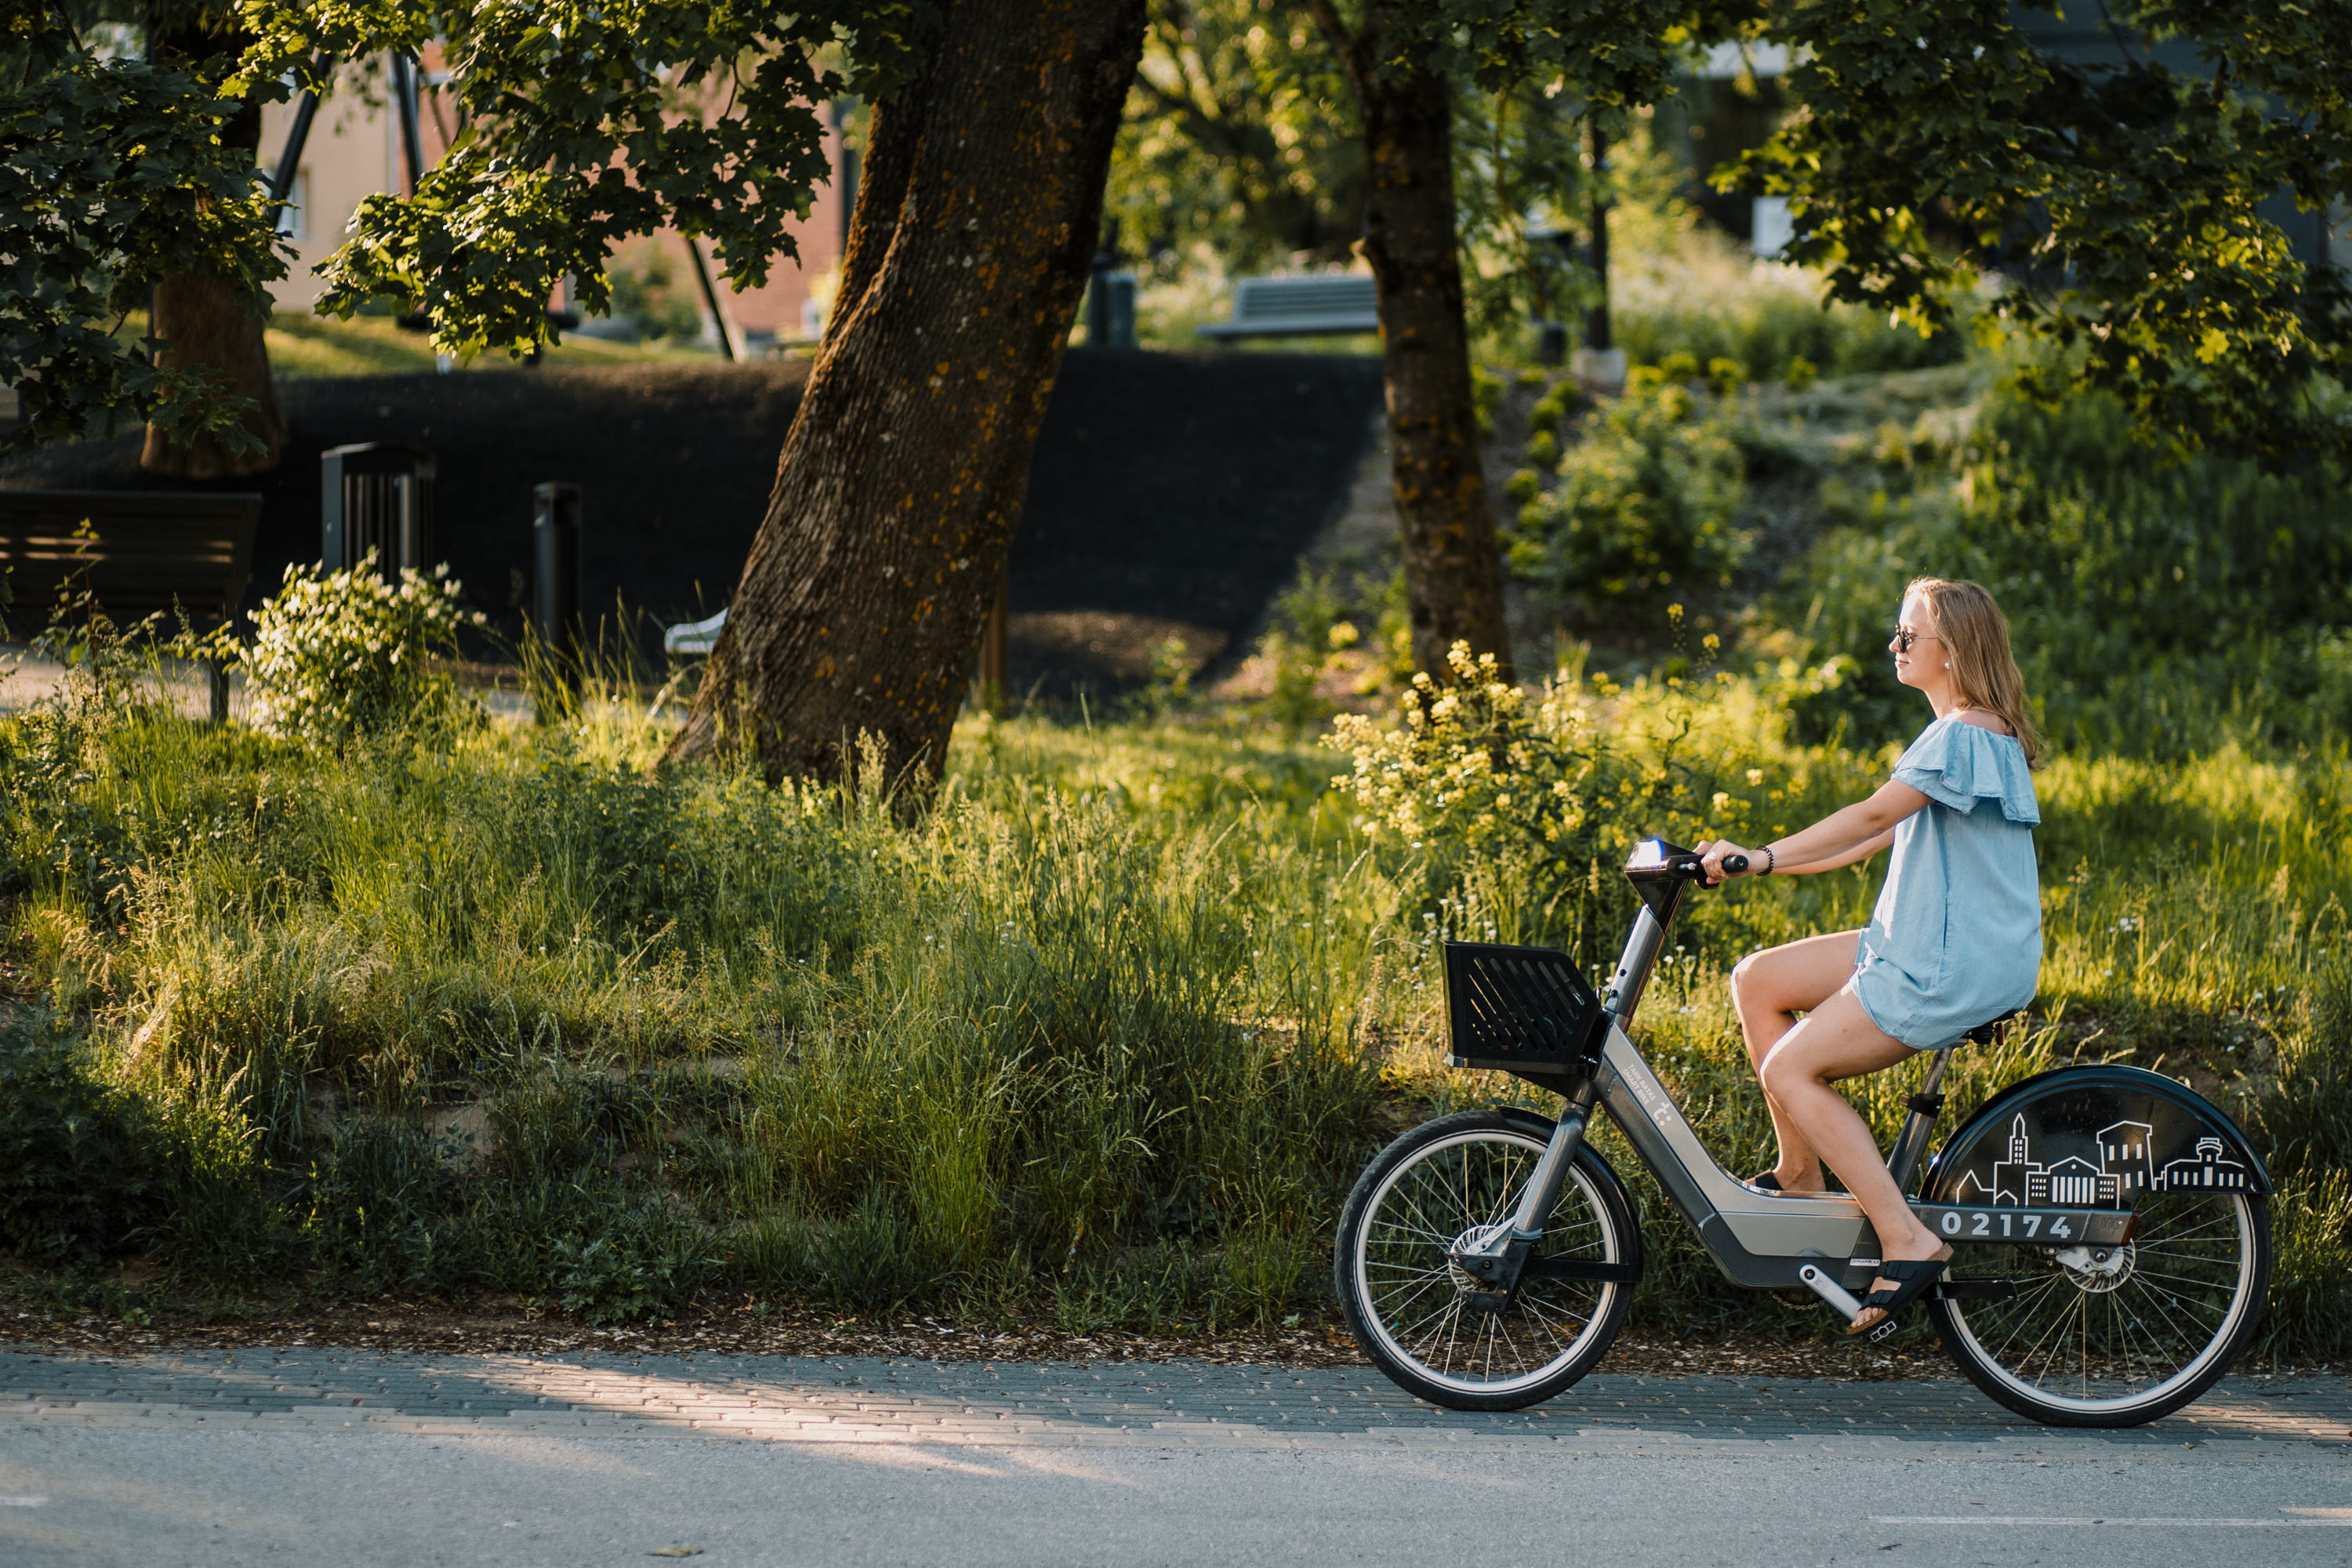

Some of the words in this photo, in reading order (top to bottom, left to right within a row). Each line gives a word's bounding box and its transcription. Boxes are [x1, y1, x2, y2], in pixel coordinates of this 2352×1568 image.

[1622, 1069, 1640, 1090] SMART
[1637, 1089, 1651, 1105] BIKE
[1628, 1064, 1642, 1081] TARK
[1639, 1080, 1657, 1101] RATAS
[1941, 1211, 2071, 1239] 02174
